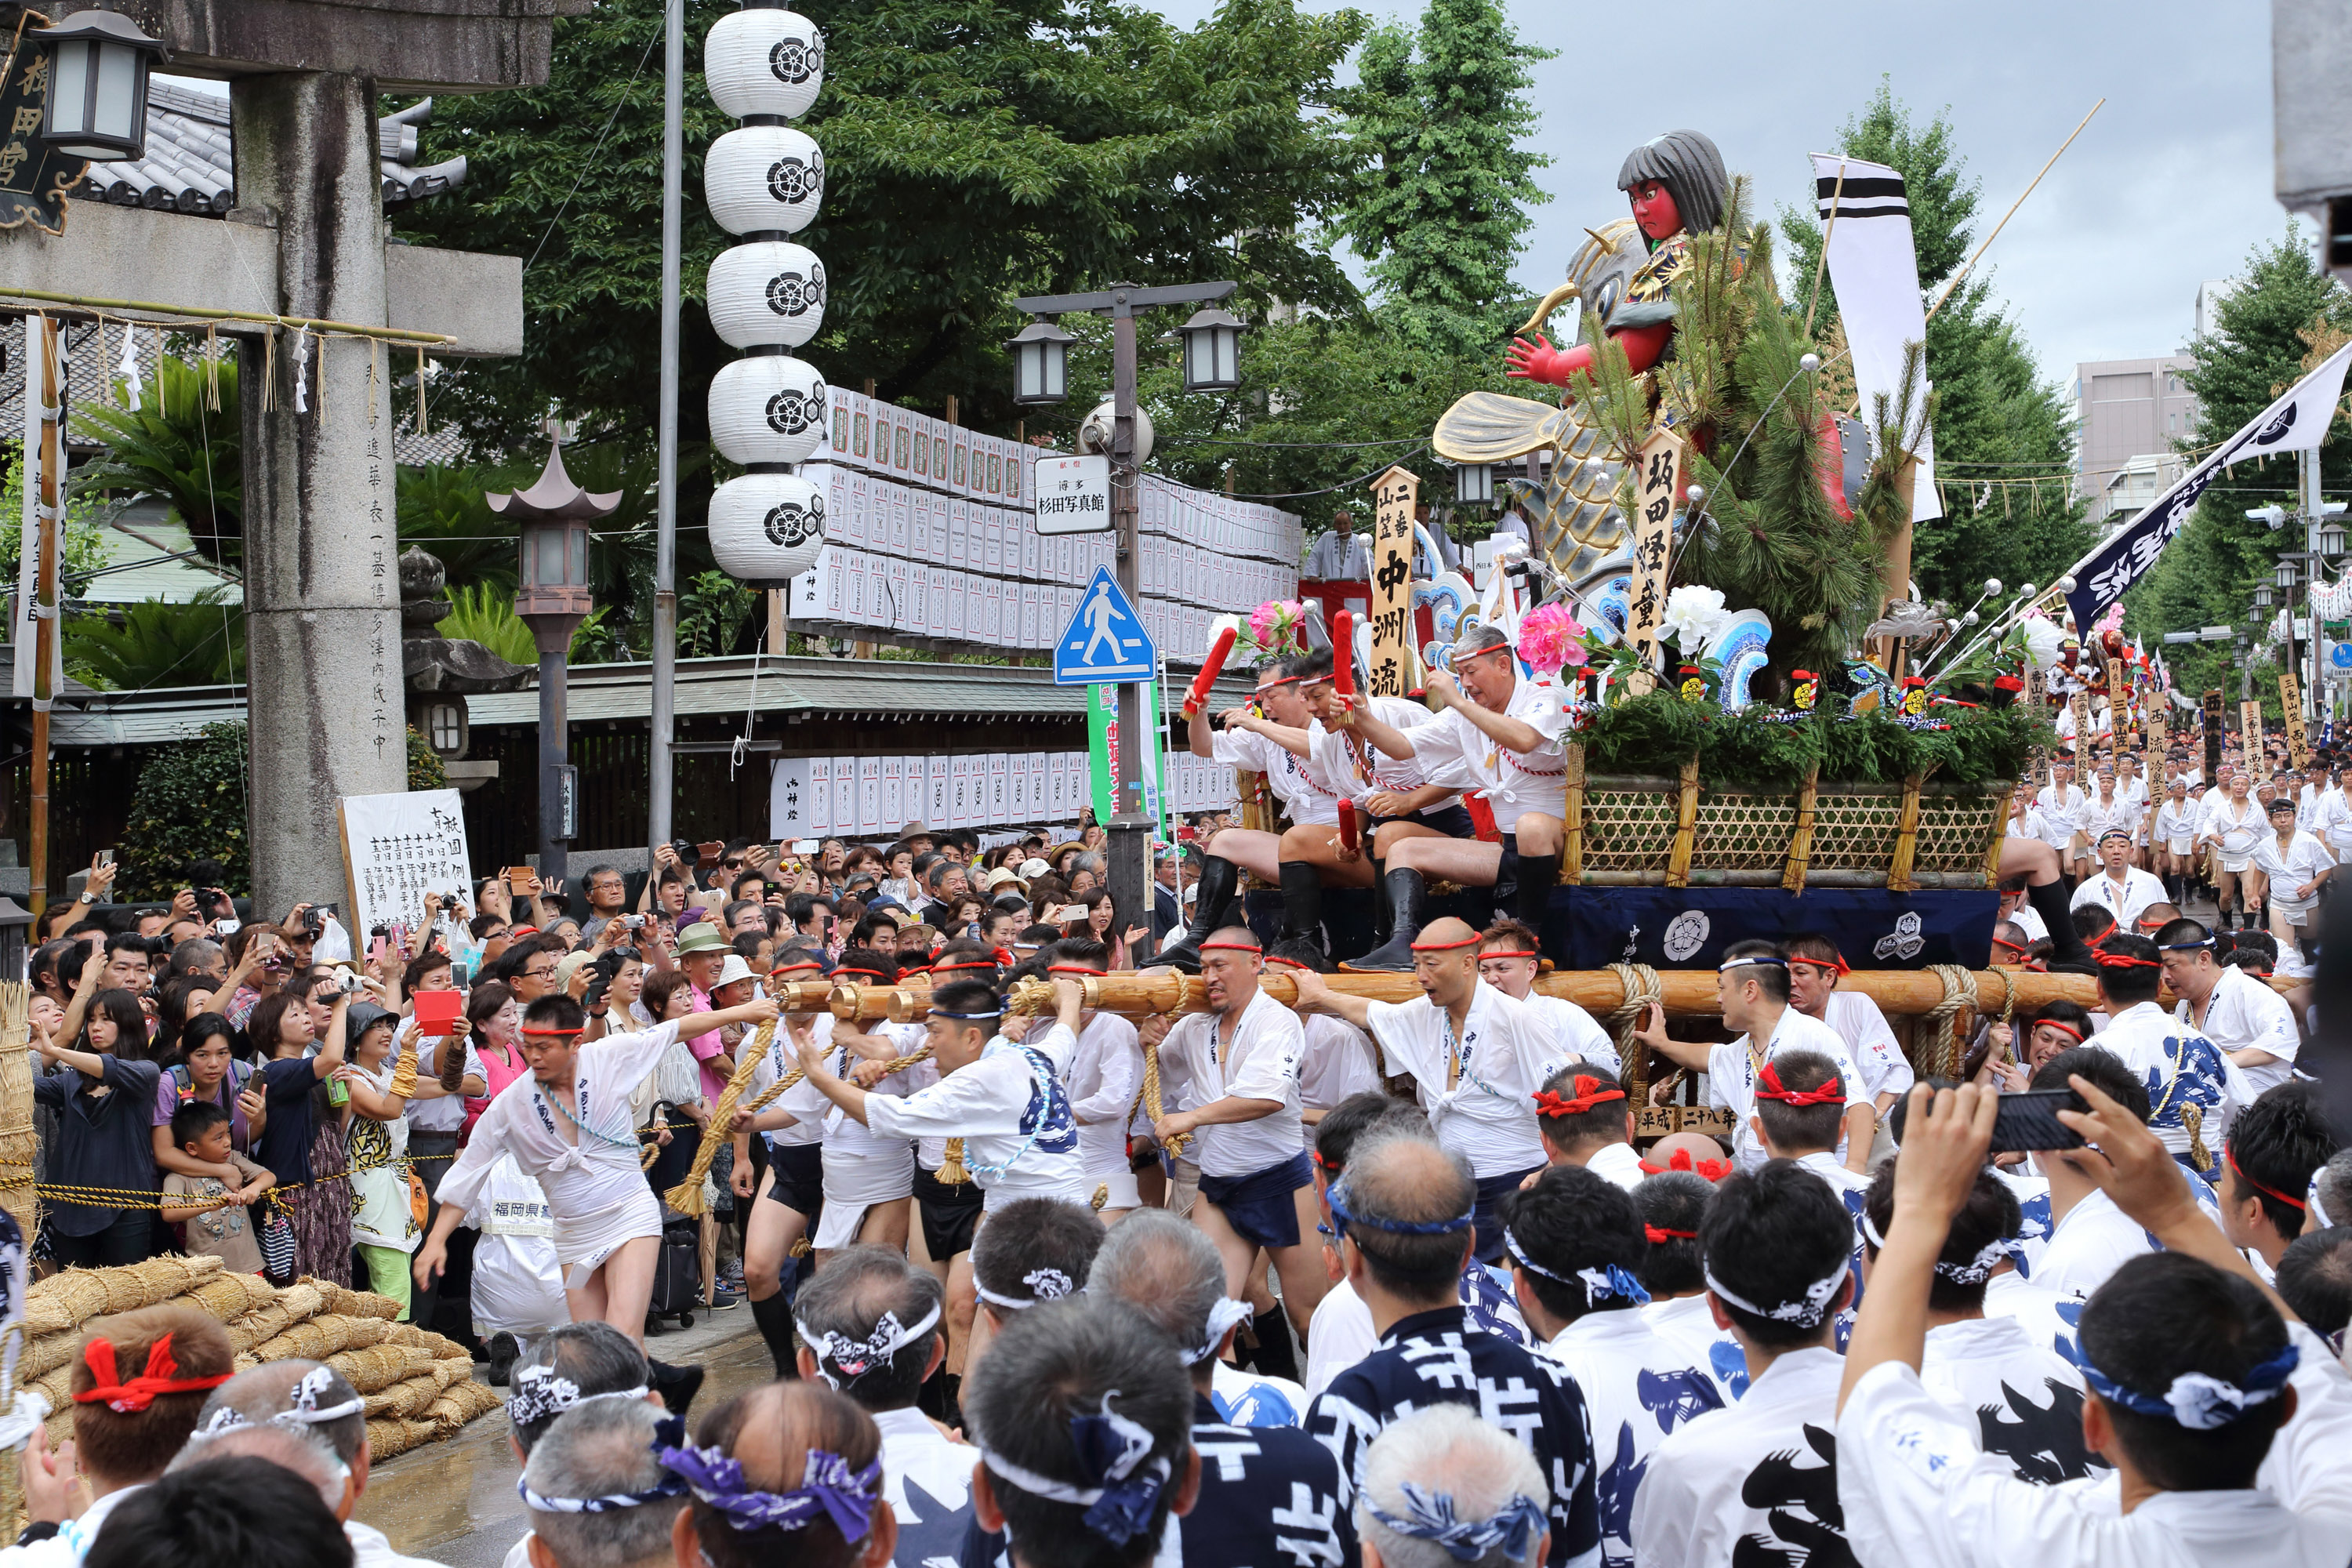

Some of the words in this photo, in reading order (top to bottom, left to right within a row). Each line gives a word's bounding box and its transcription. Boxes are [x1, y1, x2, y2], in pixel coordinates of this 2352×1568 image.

[1058, 479, 1083, 492] 博多
[1038, 493, 1104, 515] 杉田写真館
[1379, 488, 1393, 540] 山笠
[1396, 485, 1410, 538] 二番
[1475, 561, 1492, 570] 西日本
[1370, 550, 1409, 697] 中洲流
[2285, 679, 2300, 723] 三番山笠
[2245, 711, 2259, 749] 三番山笠
[2291, 729, 2308, 757] 西流
[2249, 753, 2263, 775] 西流
[2150, 760, 2164, 808] 冷泉三区
[442, 815, 469, 904] 祇園例大
[416, 862, 428, 888] 早朝
[1282, 1054, 1294, 1079] 中二
[1642, 1109, 1672, 1131] 平成
[1682, 1109, 1737, 1131] 二十八年
